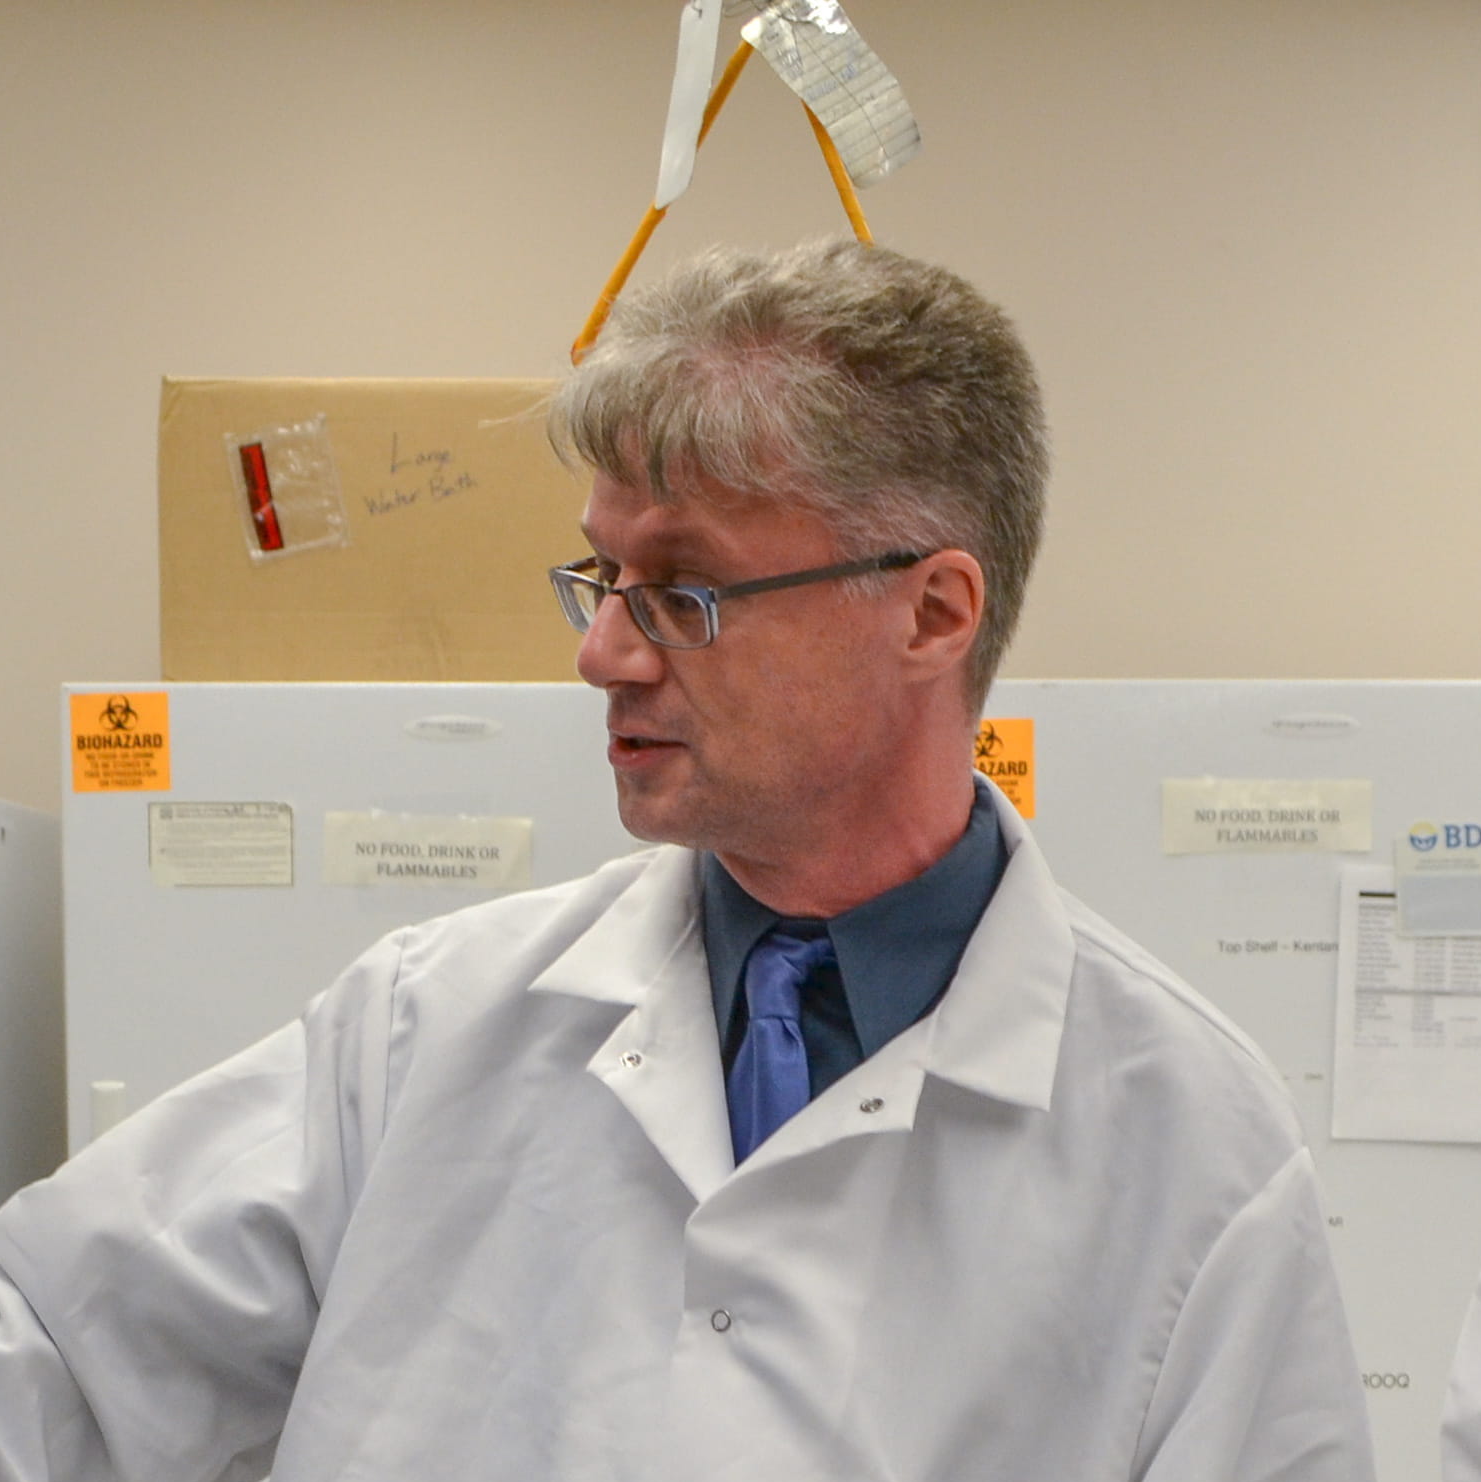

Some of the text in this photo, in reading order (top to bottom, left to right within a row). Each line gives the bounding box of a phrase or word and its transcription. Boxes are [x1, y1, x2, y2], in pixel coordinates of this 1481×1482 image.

[389, 431, 452, 473] Large
[363, 471, 479, 516] Water Bath
[76, 734, 163, 751] BIOHAZARD
[978, 760, 1028, 776] AZARD
[1195, 809, 1341, 824] NO FOOD, DRINK OR
[1217, 828, 1319, 842] FLAMMABLES
[355, 842, 500, 860] NO FOOD, DRINK OR
[376, 862, 478, 879] FLAMMABLES
[1217, 940, 1242, 955] Top
[1245, 940, 1278, 953] Shelf
